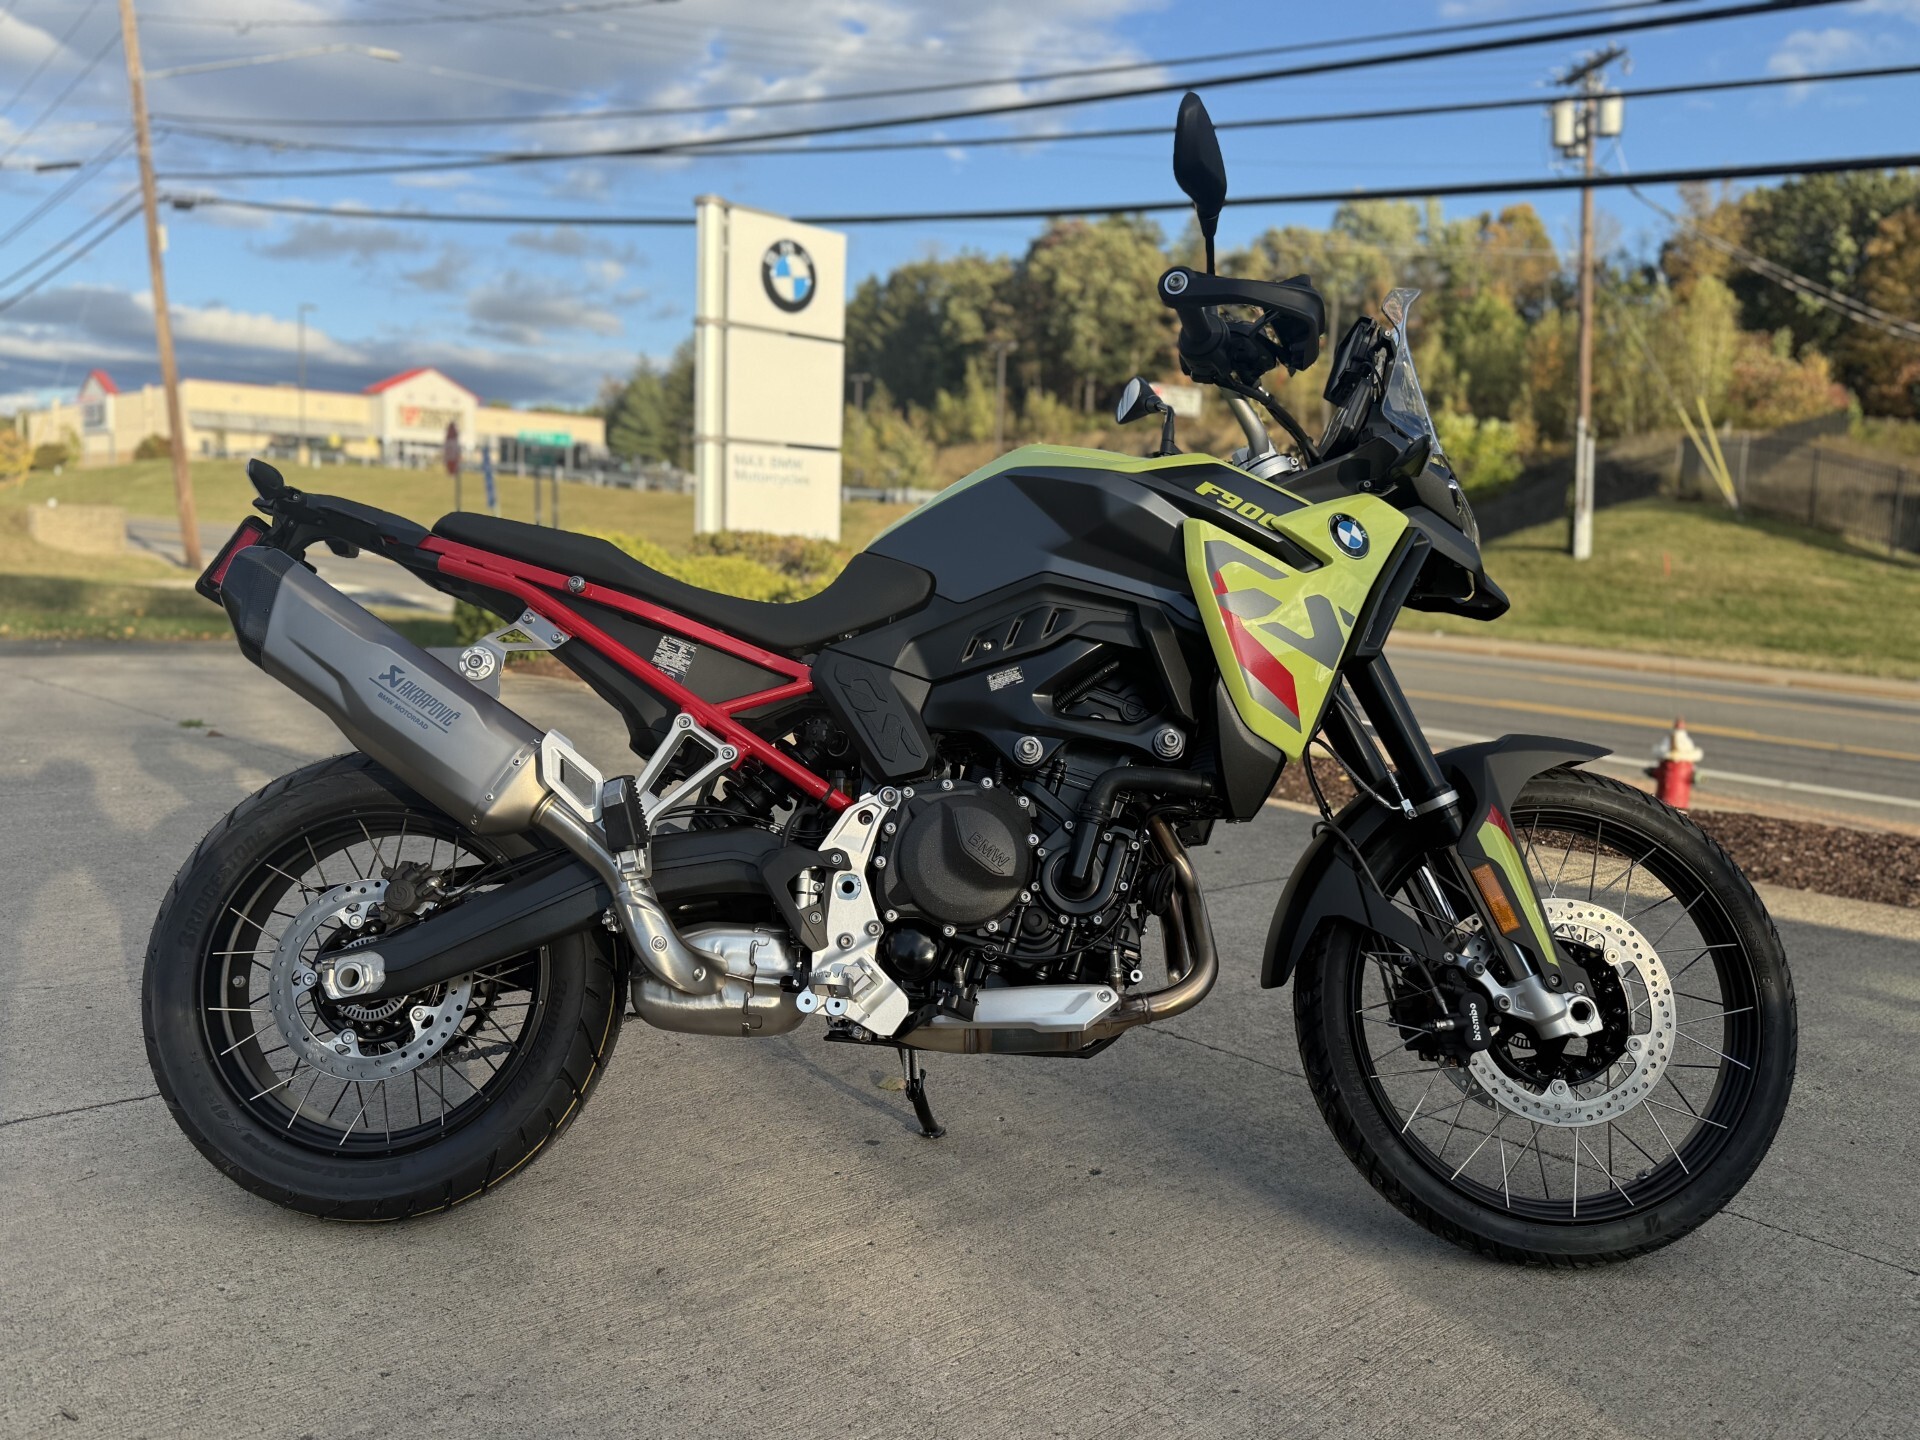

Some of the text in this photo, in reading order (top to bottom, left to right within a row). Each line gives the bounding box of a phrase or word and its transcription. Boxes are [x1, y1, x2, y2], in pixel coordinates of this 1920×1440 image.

[377, 691, 429, 730] BMW MOTORRAD
[967, 831, 1010, 867] BMW
[1469, 1003, 1481, 1041] brembo
